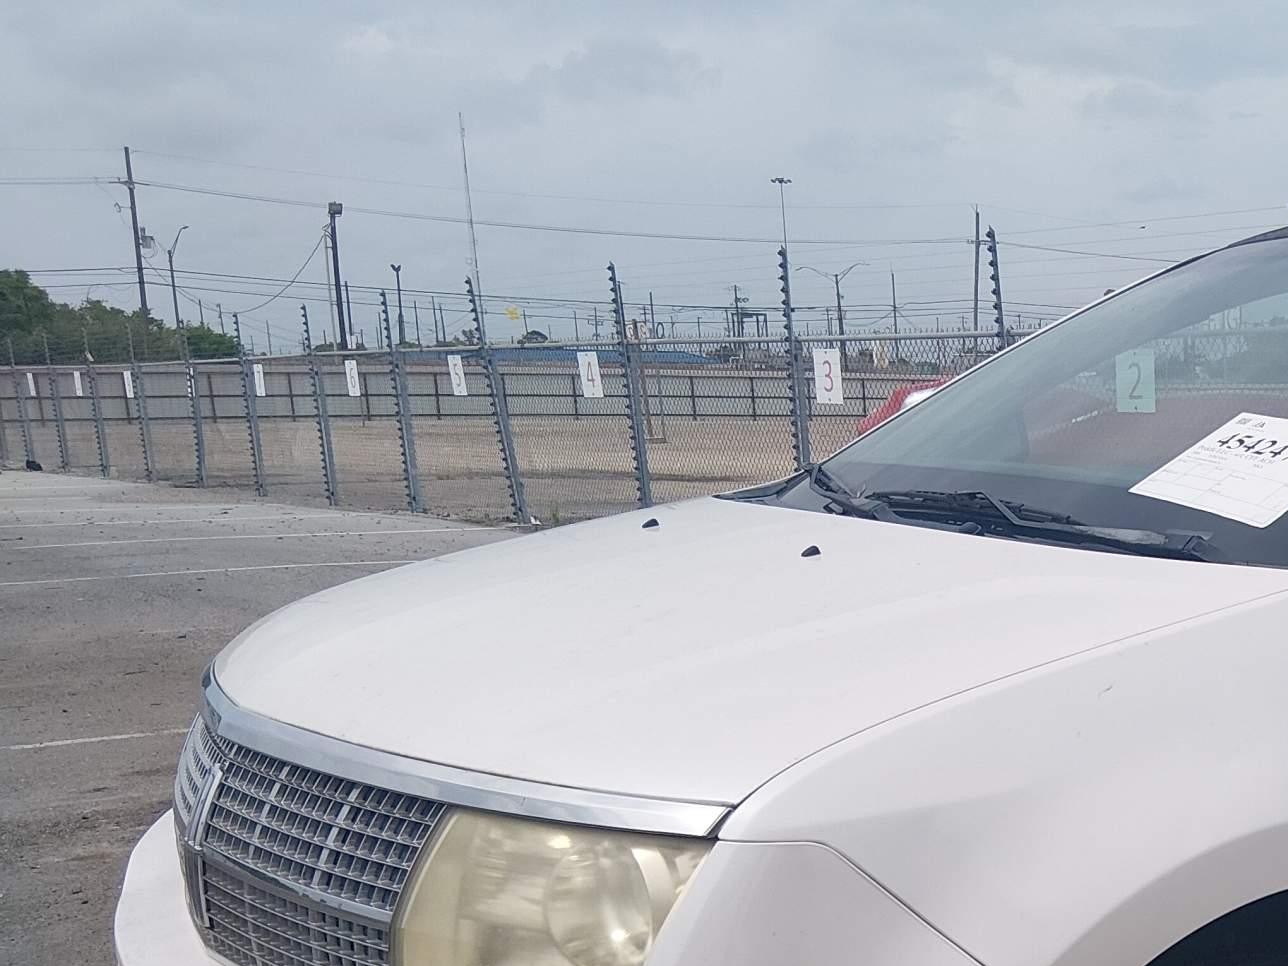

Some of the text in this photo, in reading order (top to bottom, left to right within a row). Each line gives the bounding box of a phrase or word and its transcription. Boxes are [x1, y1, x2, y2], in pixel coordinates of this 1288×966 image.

[453, 363, 462, 387] 5
[586, 361, 596, 388] 4
[822, 360, 834, 392] 3
[1128, 362, 1144, 400] 2
